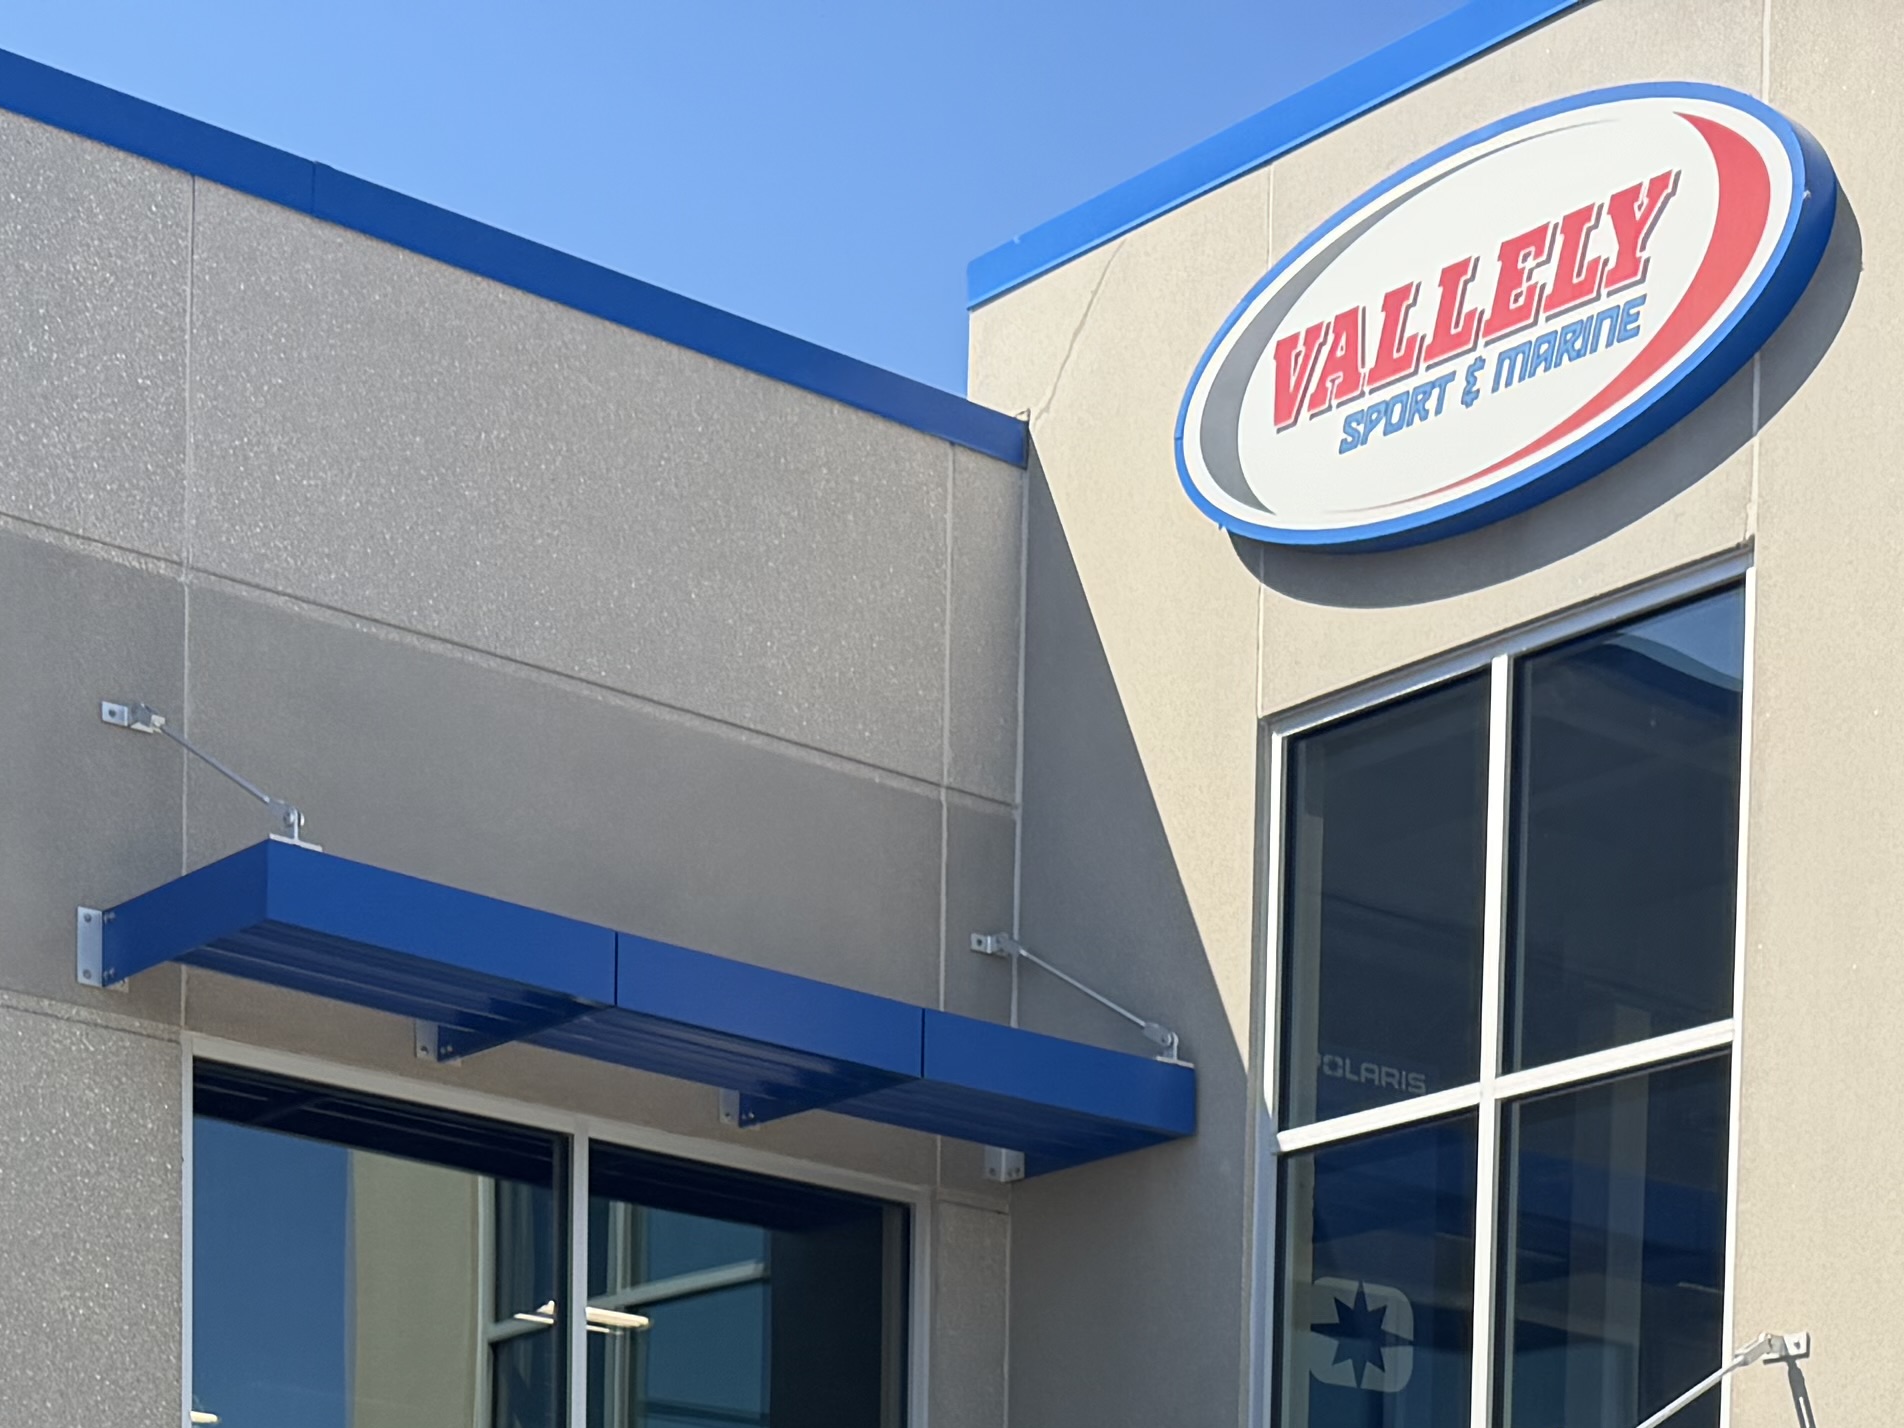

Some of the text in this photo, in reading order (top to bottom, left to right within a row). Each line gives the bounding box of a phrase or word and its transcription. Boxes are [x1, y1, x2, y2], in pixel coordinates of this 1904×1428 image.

[1272, 169, 1683, 434] VALLELY
[1338, 292, 1648, 455] SPORT & MARINE
[1317, 1053, 1427, 1095] OLARIS
